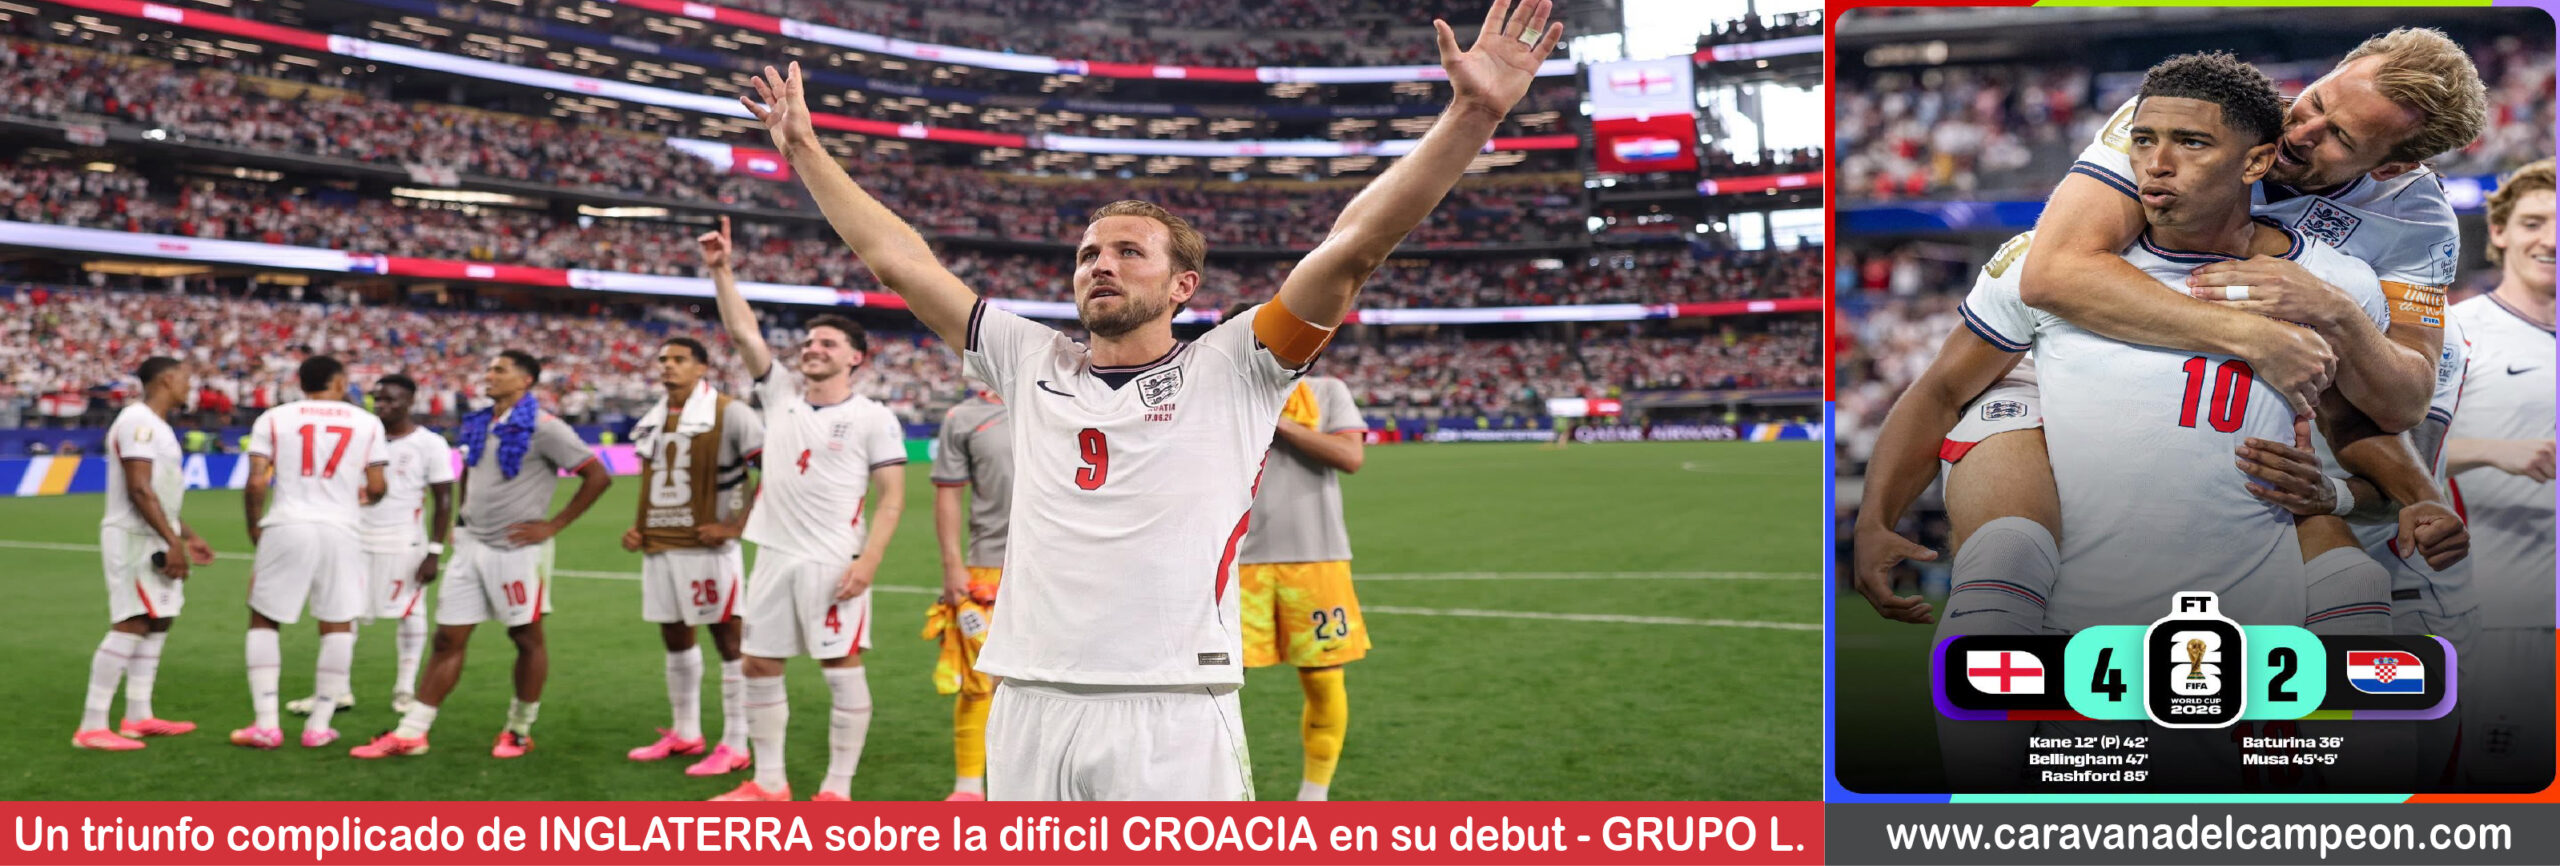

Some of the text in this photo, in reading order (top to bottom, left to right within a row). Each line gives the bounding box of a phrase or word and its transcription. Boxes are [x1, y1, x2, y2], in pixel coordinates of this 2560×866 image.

[2423, 317, 2440, 325] FIFA
[2179, 356, 2254, 433] 10
[297, 424, 355, 479] 17
[796, 449, 812, 475] 4
[1075, 428, 1109, 490] 9
[391, 580, 404, 601] 7
[502, 580, 527, 606] 10
[691, 579, 719, 606] 26
[825, 604, 842, 635] 4
[1312, 607, 1348, 641] 23
